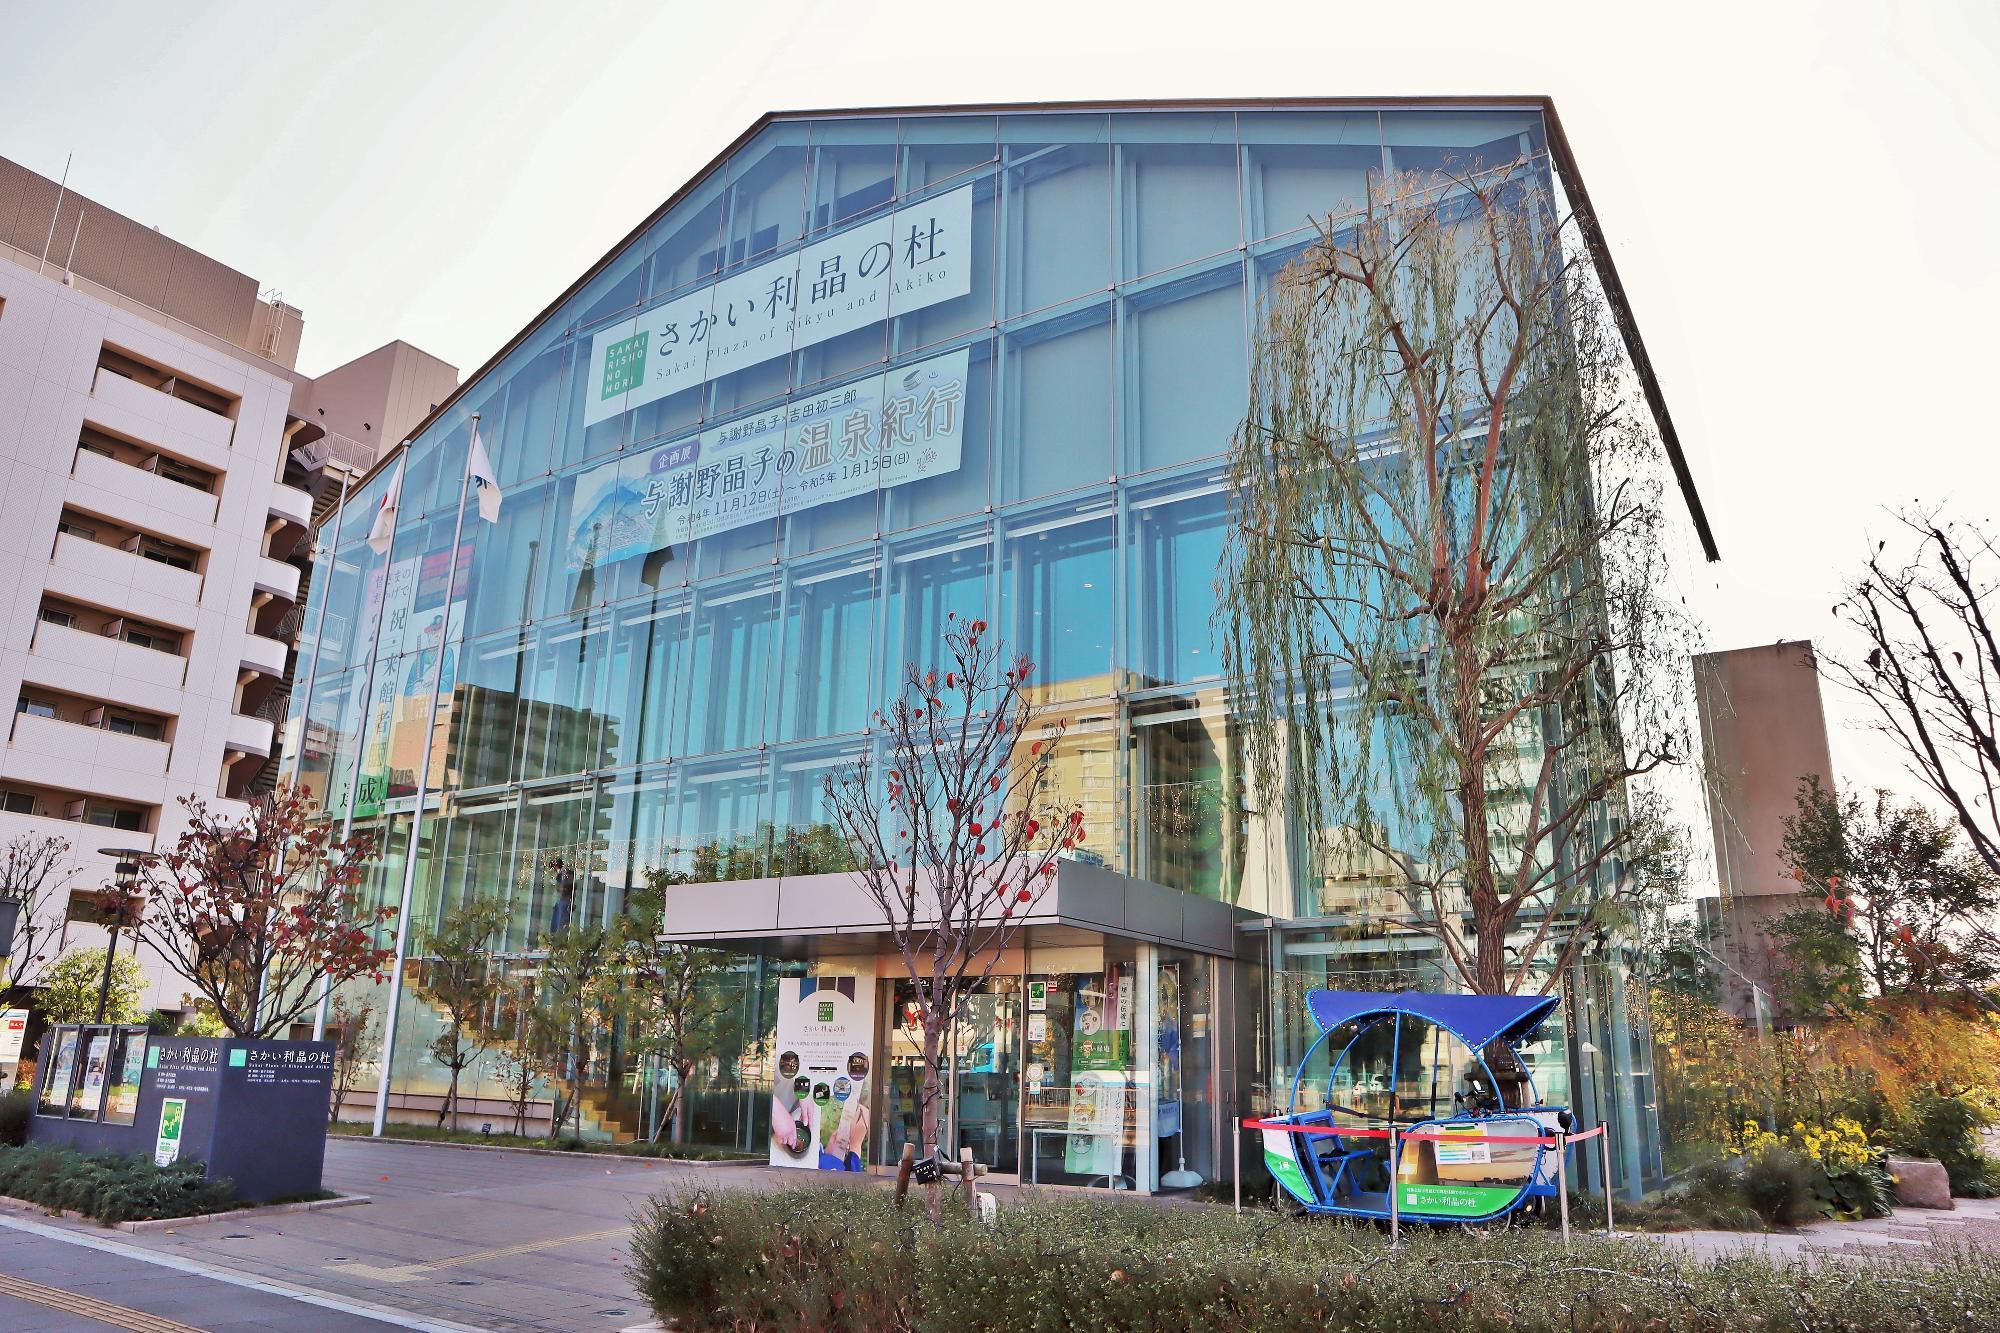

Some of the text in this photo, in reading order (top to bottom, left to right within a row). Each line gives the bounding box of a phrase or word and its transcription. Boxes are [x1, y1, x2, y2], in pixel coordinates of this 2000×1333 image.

[659, 217, 947, 357] さかい利晶の杜
[655, 269, 947, 380] Sakai Plaza of Rikyu and Akiko
[609, 336, 646, 358] SAKAI
[607, 349, 644, 369] RISHO
[604, 378, 634, 395] MORI
[606, 371, 621, 382] NO
[657, 445, 692, 470] 企画展
[158, 1045, 219, 1065] さかい利晶の杜
[249, 1049, 331, 1065] さかい利晶の杜
[1420, 1196, 1477, 1208] さかい利晶の杜
